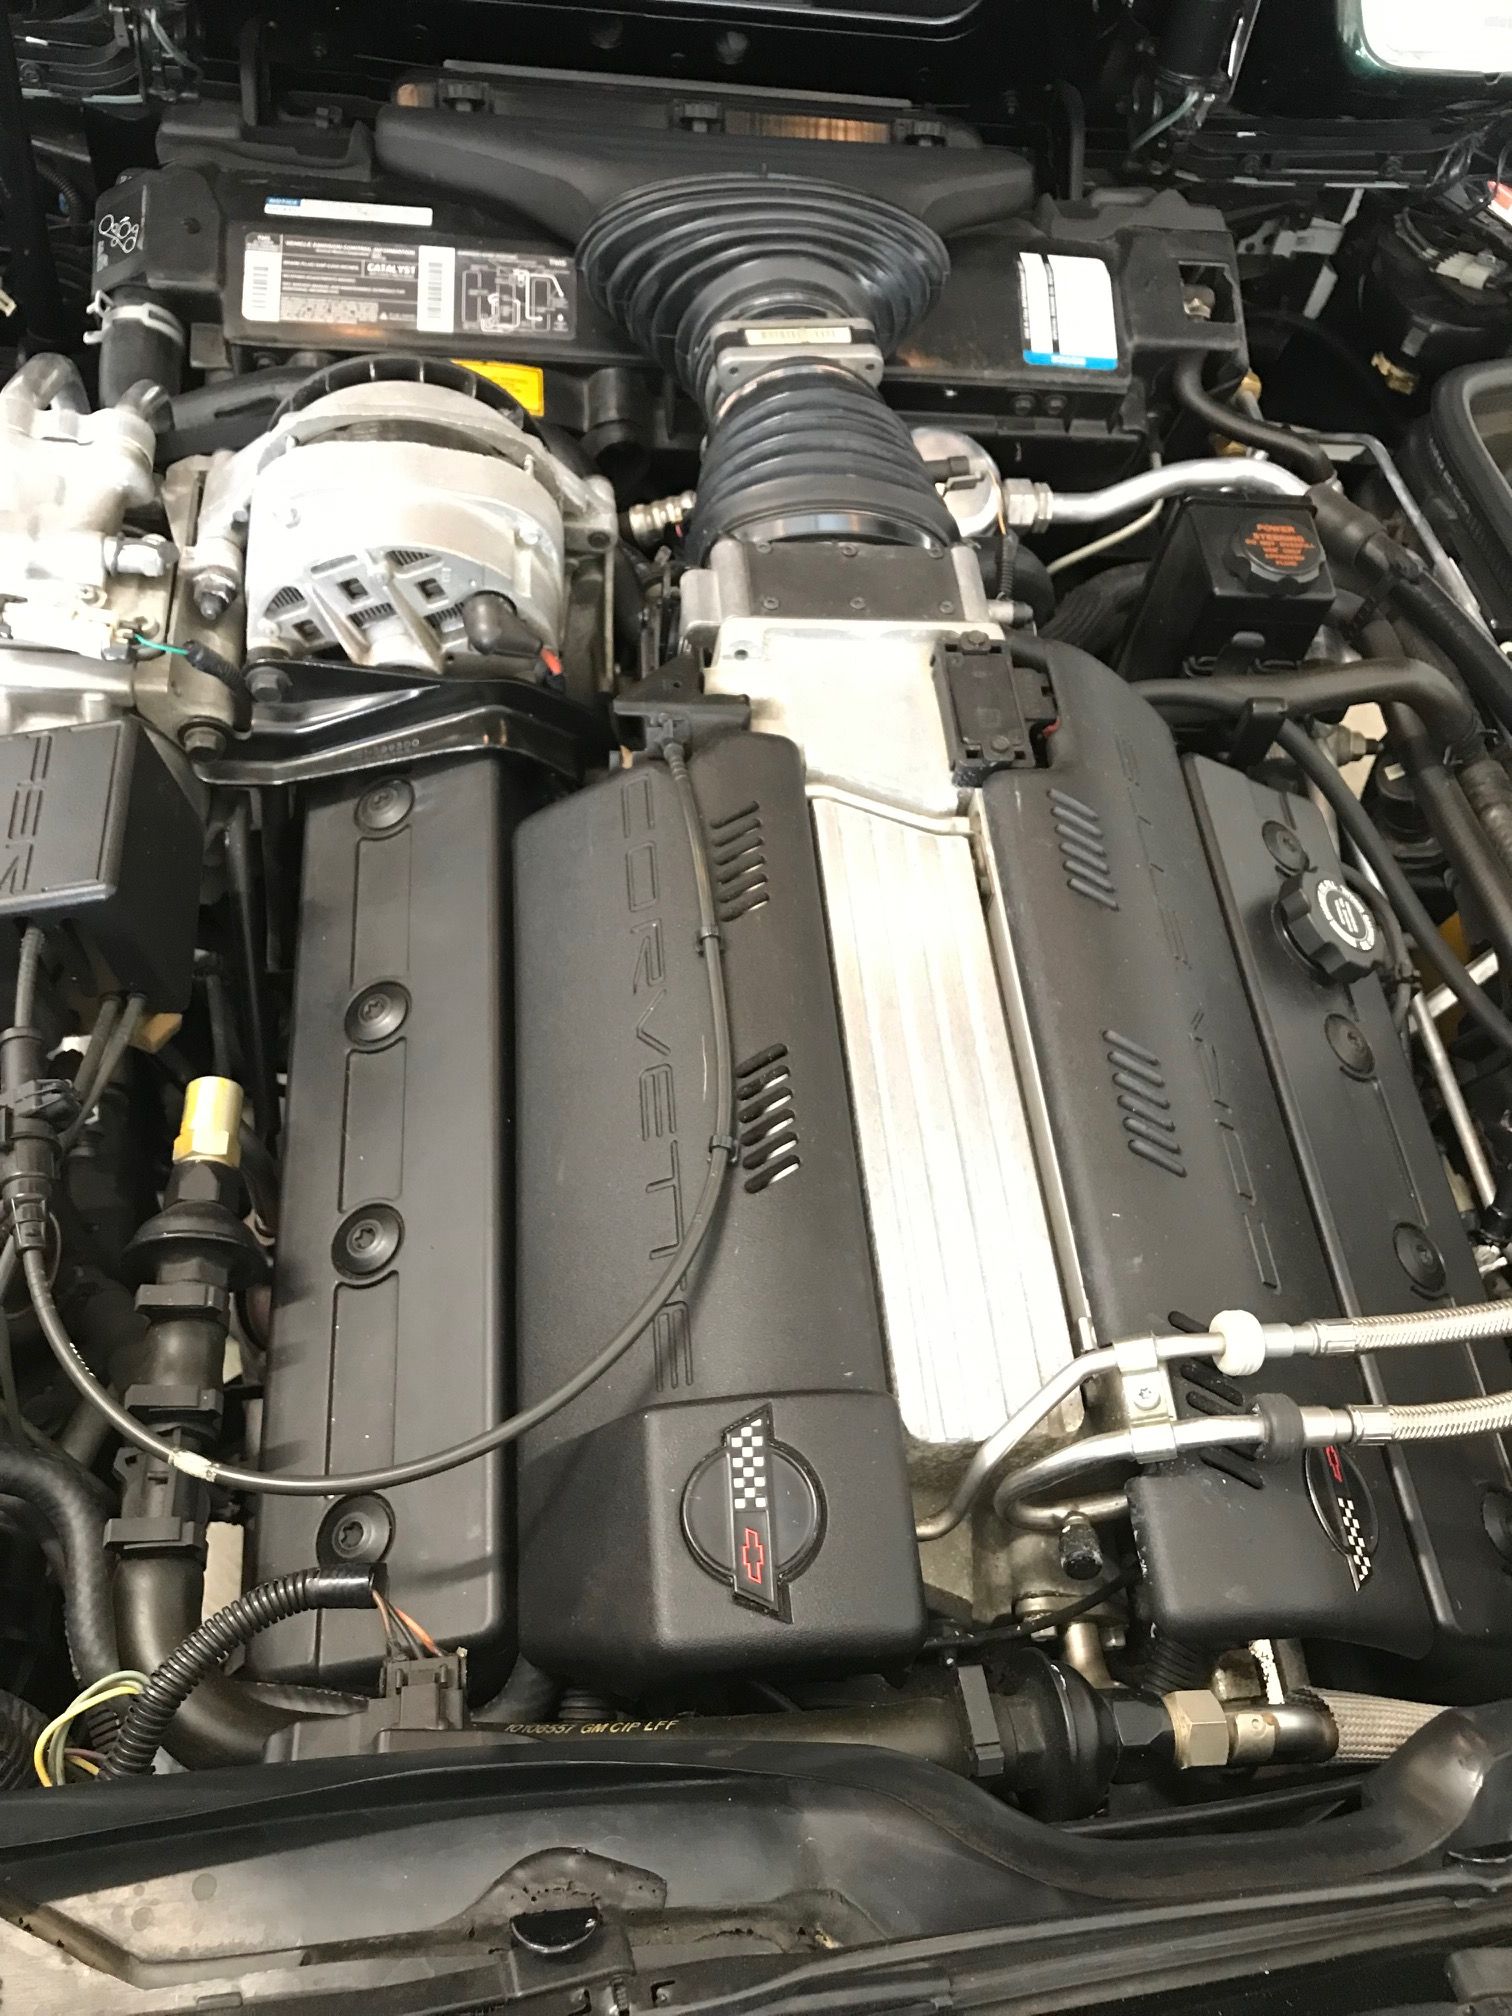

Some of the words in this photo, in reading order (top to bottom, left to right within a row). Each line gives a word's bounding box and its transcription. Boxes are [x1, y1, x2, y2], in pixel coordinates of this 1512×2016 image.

[366, 262, 416, 275] CATALYST
[1256, 523, 1296, 533] POWER
[620, 773, 695, 1393] CORVETTE
[581, 1722, 609, 1734] GM
[609, 1721, 641, 1733] CIP
[643, 1720, 679, 1731] LFF
